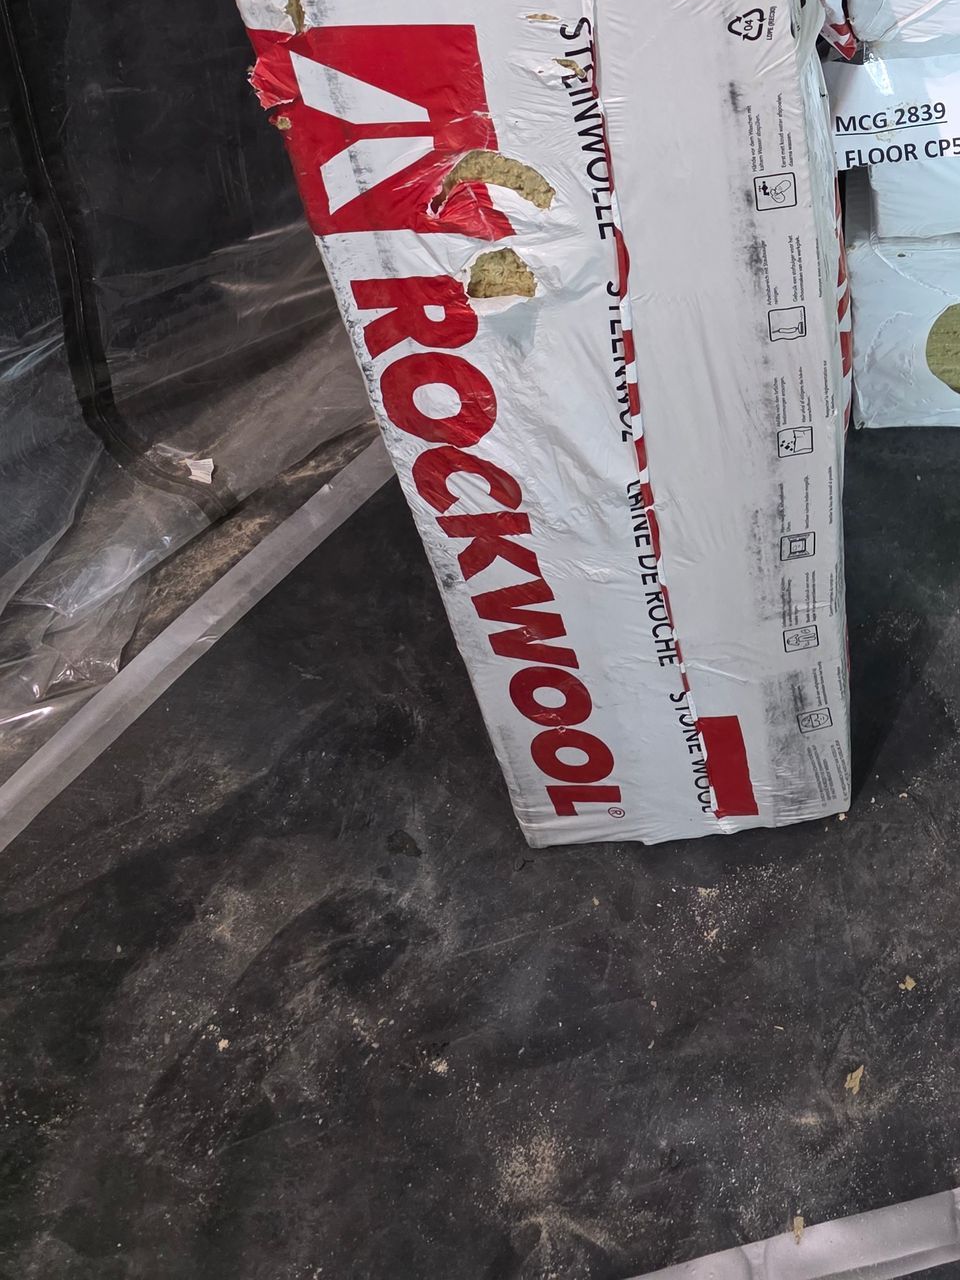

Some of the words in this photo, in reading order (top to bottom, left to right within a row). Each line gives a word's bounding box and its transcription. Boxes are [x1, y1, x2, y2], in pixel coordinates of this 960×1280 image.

[743, 19, 754, 32] 04
[835, 110, 888, 132] MCG
[894, 102, 946, 126] 2839
[845, 142, 918, 168] FLOOR
[350, 274, 622, 816] ROCKWOOL
[645, 591, 679, 667] ROCHE
